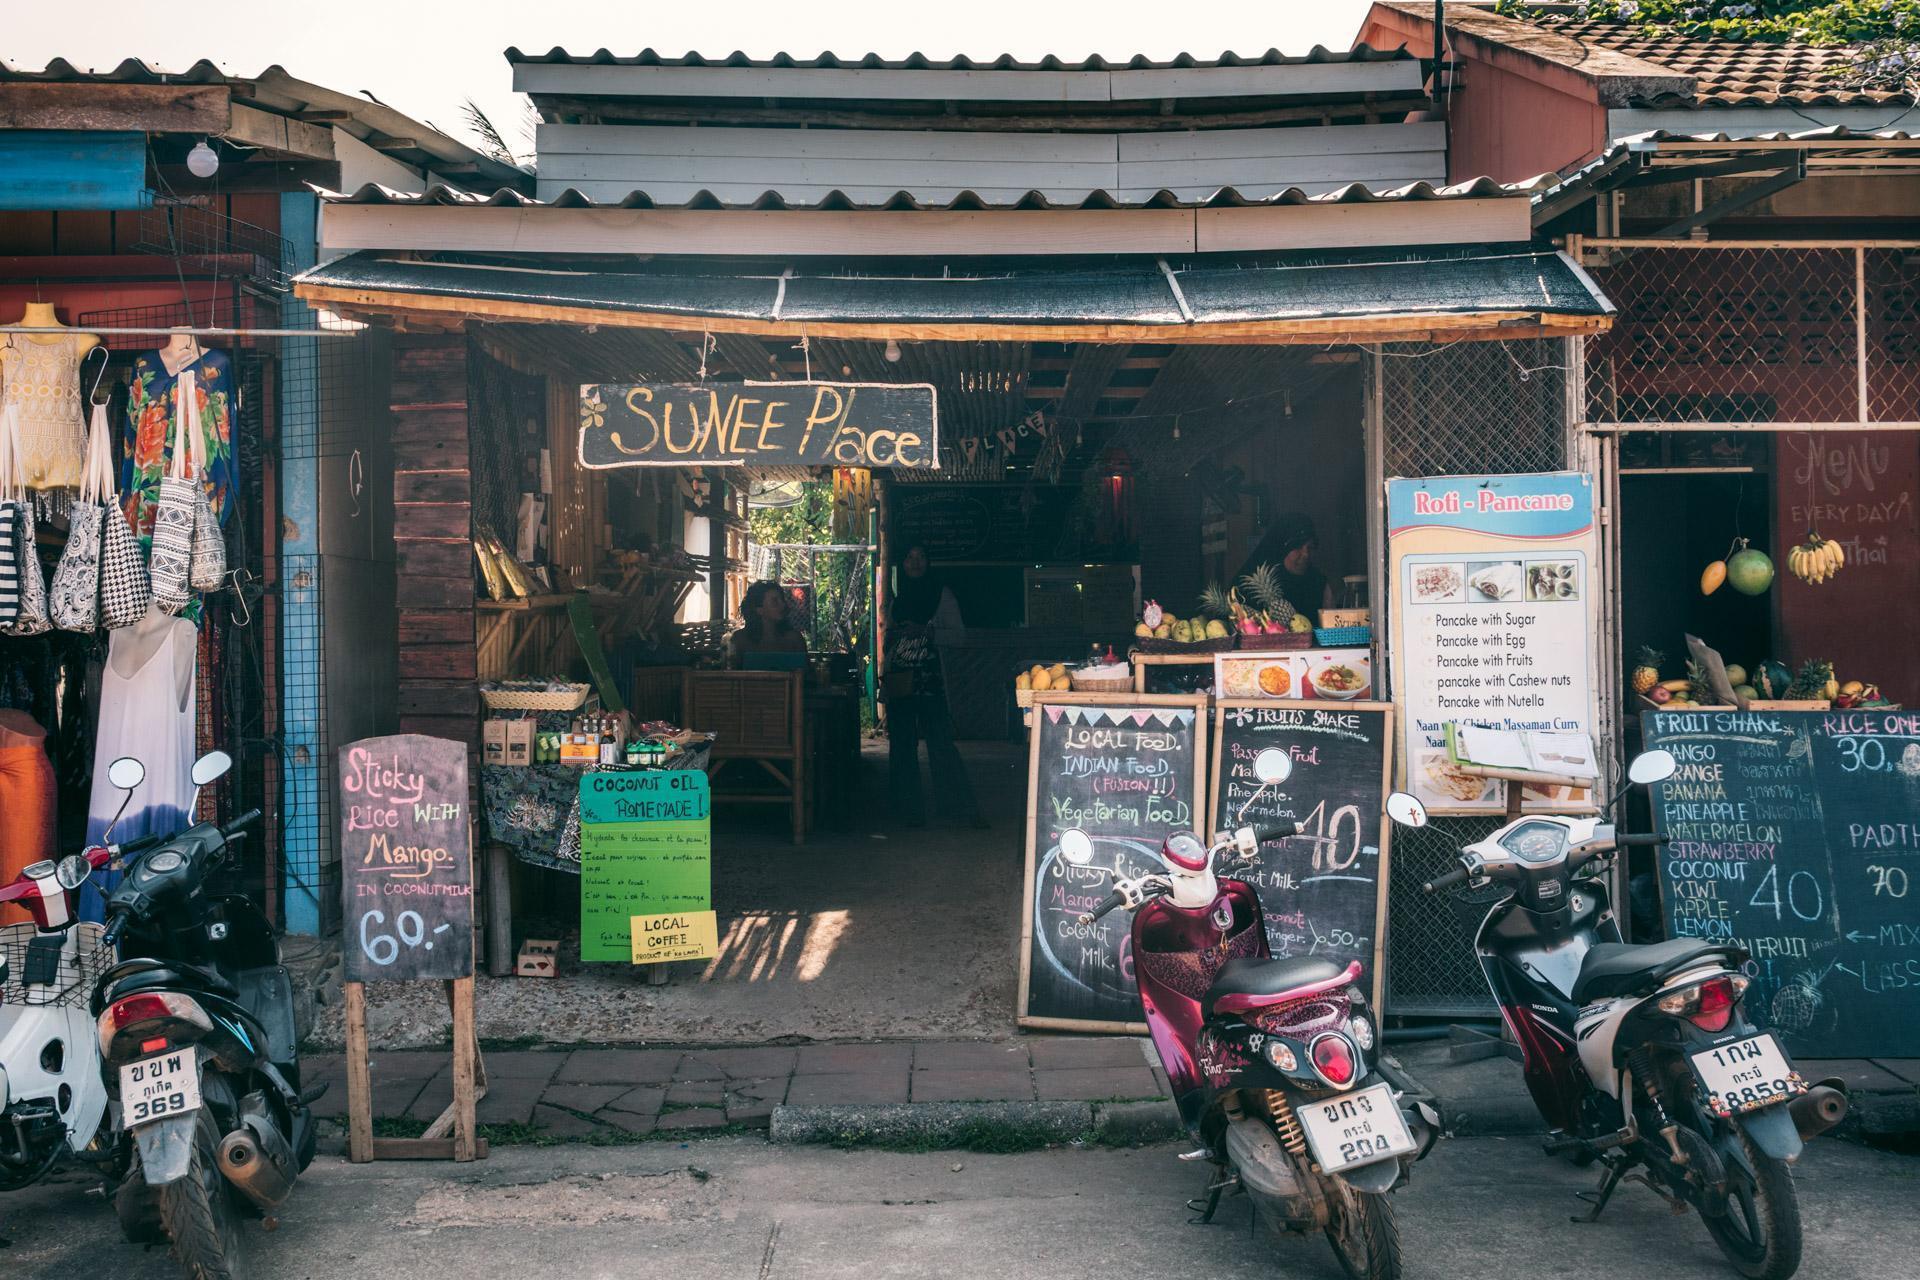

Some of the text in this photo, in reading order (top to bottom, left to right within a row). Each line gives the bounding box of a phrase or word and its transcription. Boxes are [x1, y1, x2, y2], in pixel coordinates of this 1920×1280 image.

[610, 387, 790, 454] SUNEE
[1415, 491, 1459, 515] Roti
[1478, 490, 1574, 513] Pancane
[1436, 612, 1536, 629] Pancake with Sugar
[1436, 633, 1526, 648] Pancake with Egg
[1437, 653, 1533, 667] Pancake with Fruits
[1437, 673, 1571, 691] pancake with Cashew nuts
[1438, 694, 1544, 708] Pancake with Nutella
[1256, 708, 1360, 729] FRUITS SHAKE
[1416, 719, 1439, 731] Naan
[1503, 718, 1550, 731] Massaman
[1553, 717, 1579, 732] Curry
[1655, 714, 1783, 733] FRUIT SHAKE
[1824, 714, 1879, 736] RICE
[1065, 727, 1127, 749] LOCAL
[345, 748, 424, 803] Sticky
[1061, 755, 1119, 777] INDIAN
[594, 775, 698, 793] COCONUT OIL
[1662, 783, 1727, 801] BANANA
[349, 803, 460, 832] Rice WITH
[1051, 796, 1139, 827] Vegetarian
[1666, 822, 1782, 844] WATERMELON
[1668, 841, 1776, 861] STRAWBERRY
[1668, 861, 1748, 882] COCONUT
[1866, 864, 1908, 898] 70
[356, 884, 377, 896] IN
[1672, 880, 1718, 900] KIWI
[1749, 863, 1823, 921] 40
[644, 917, 689, 931] LOCAL
[1674, 918, 1732, 937] LEMON
[648, 933, 687, 947] COFFEE
[1532, 1003, 1559, 1014] HONDA
[1725, 1079, 1789, 1109] 8859
[133, 1092, 184, 1120] 369
[1340, 1134, 1390, 1162] 204
